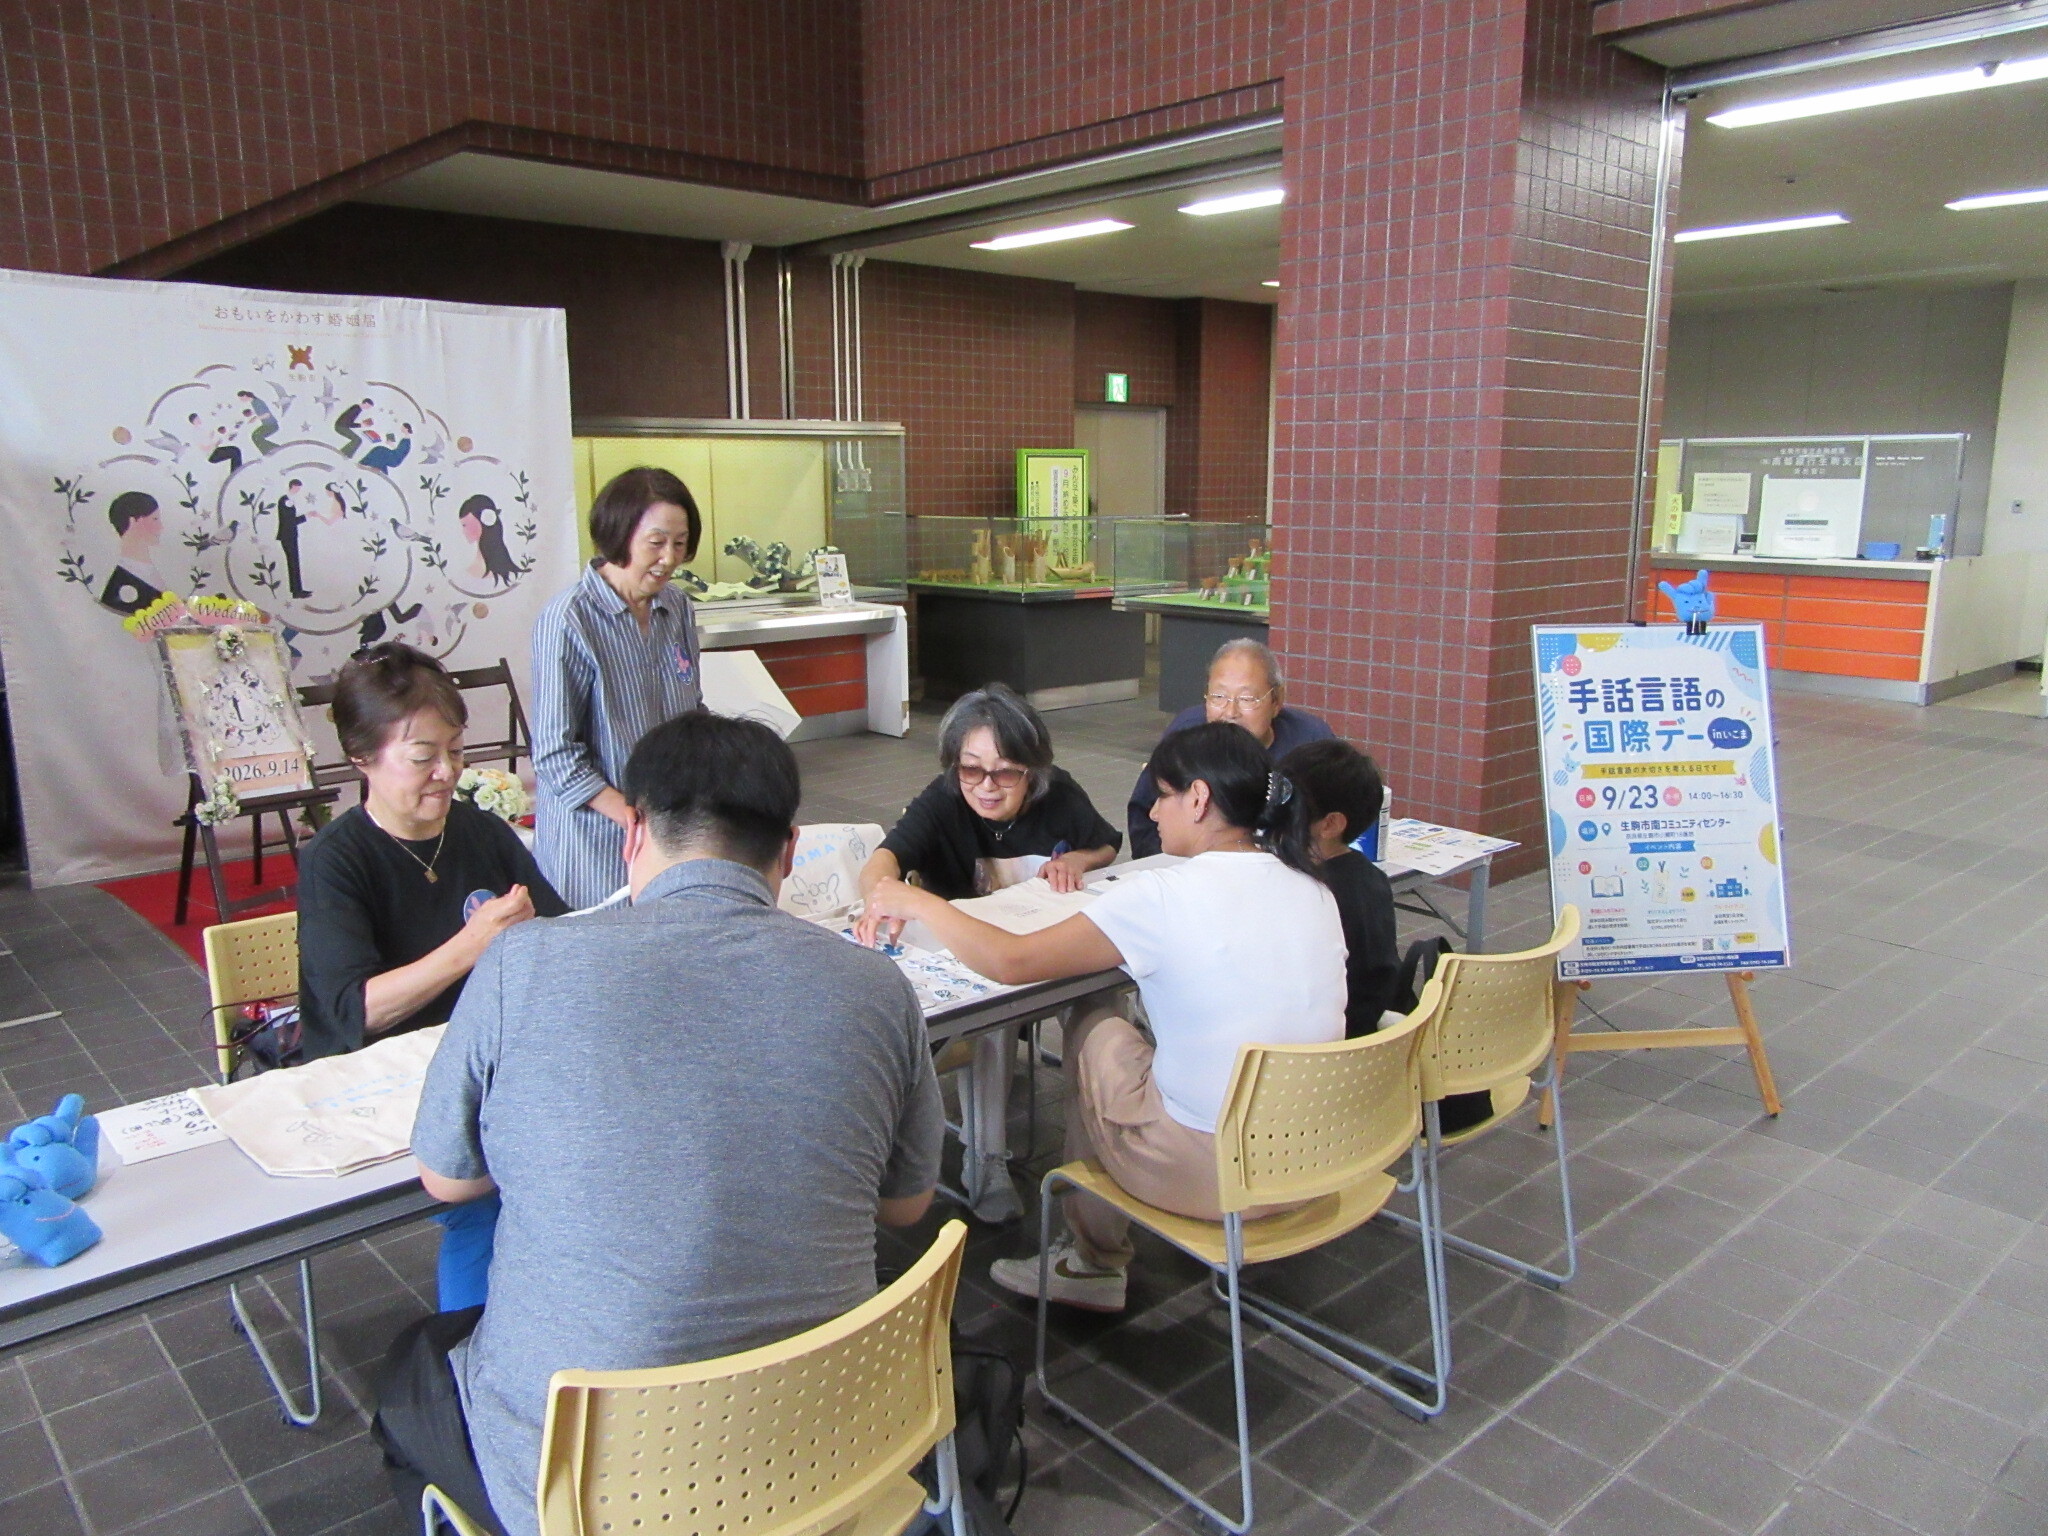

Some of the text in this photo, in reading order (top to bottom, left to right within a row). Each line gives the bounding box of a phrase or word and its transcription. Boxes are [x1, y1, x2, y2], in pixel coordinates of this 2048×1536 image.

[215, 306, 376, 328] おもいをかわす婚姻届
[136, 601, 260, 636] Happy Wedding
[1568, 676, 1726, 714] 手話言語の
[1583, 717, 1705, 754] 国際デー
[1600, 764, 1718, 775] 手話言語の大切さを考える日です
[1579, 794, 1593, 802] 日時
[1602, 784, 1659, 810] 9/23
[1620, 818, 1731, 831] 生駒市南コミュニティセンター
[793, 844, 836, 866] OMA
